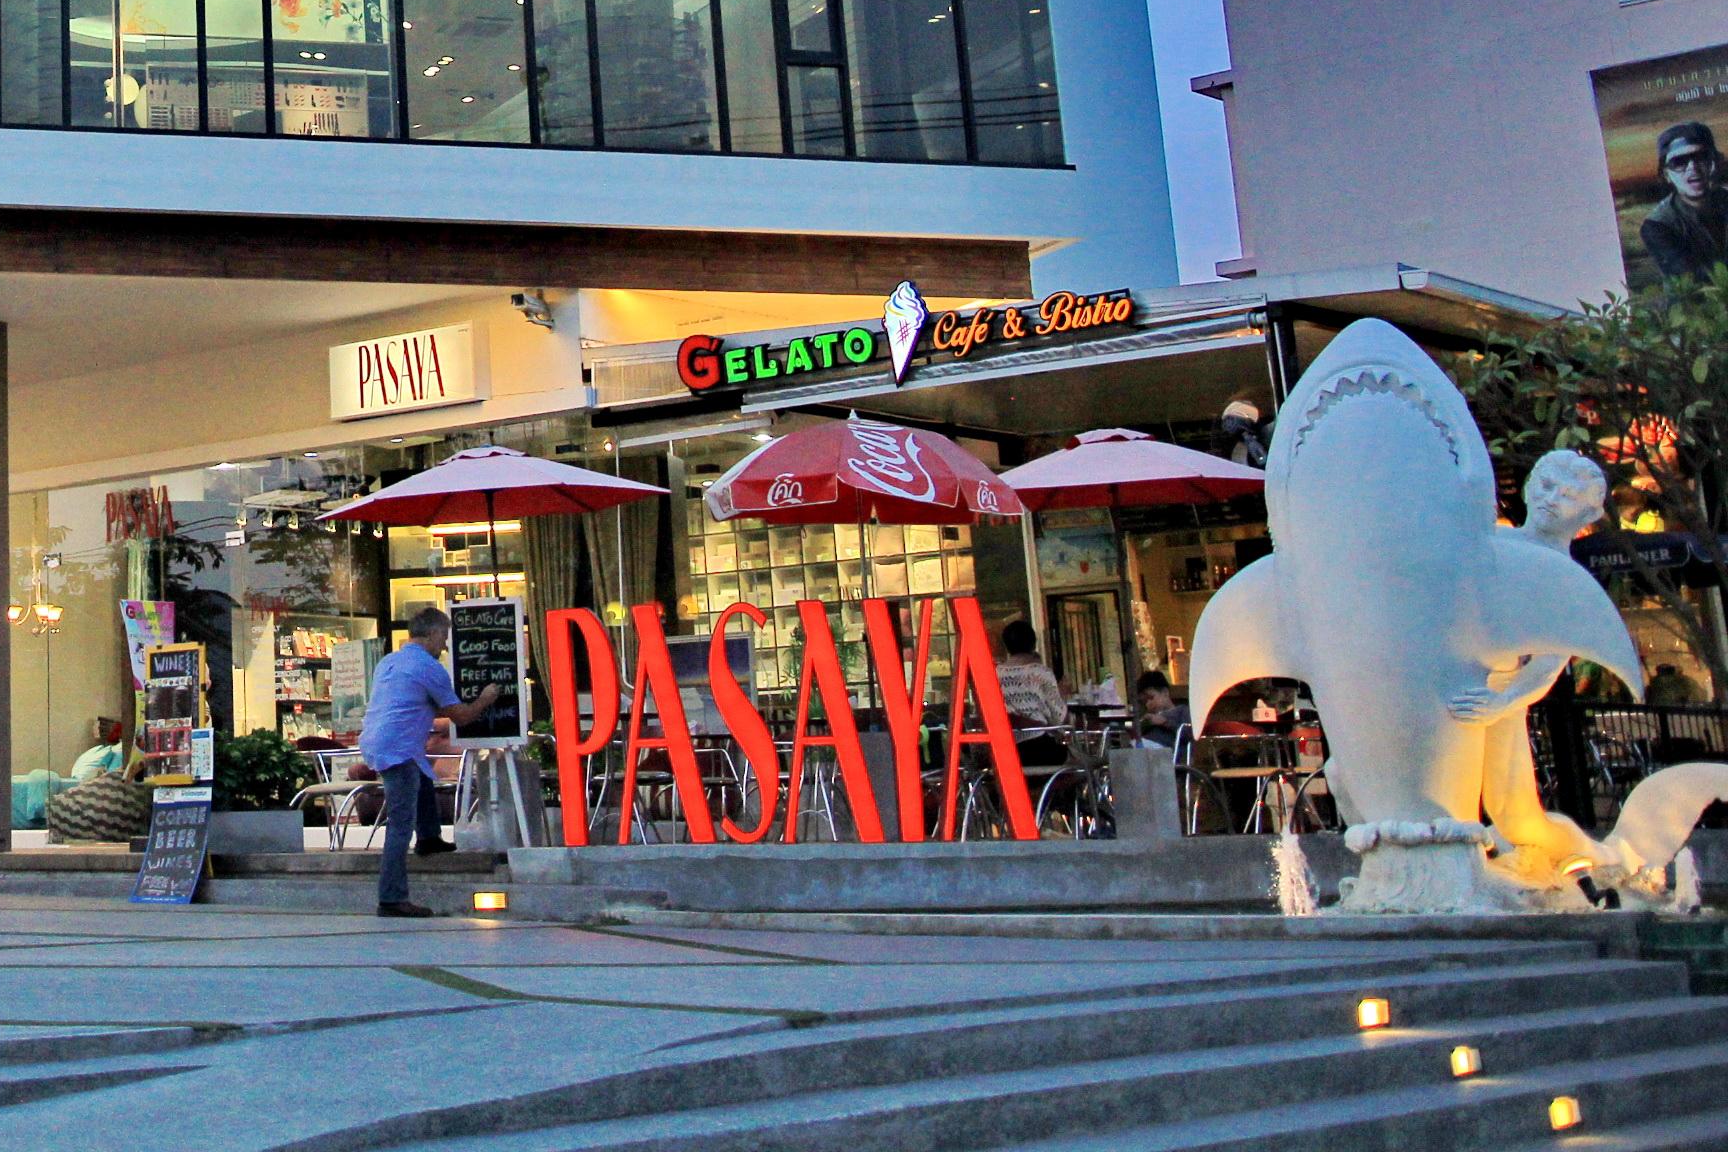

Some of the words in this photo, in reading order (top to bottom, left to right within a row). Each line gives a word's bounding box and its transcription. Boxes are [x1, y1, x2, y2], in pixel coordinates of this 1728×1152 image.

[677, 327, 874, 391] GELATO
[932, 311, 993, 358] Café
[1003, 308, 1024, 338] &
[1034, 290, 1132, 333] Bistro
[358, 334, 445, 408] PASAYA
[459, 640, 489, 654] GOOD
[154, 654, 185, 673] WINE
[460, 668, 487, 682] FREE
[461, 687, 478, 699] ICE
[546, 597, 1041, 847] PASAYA
[155, 829, 196, 849] BEER
